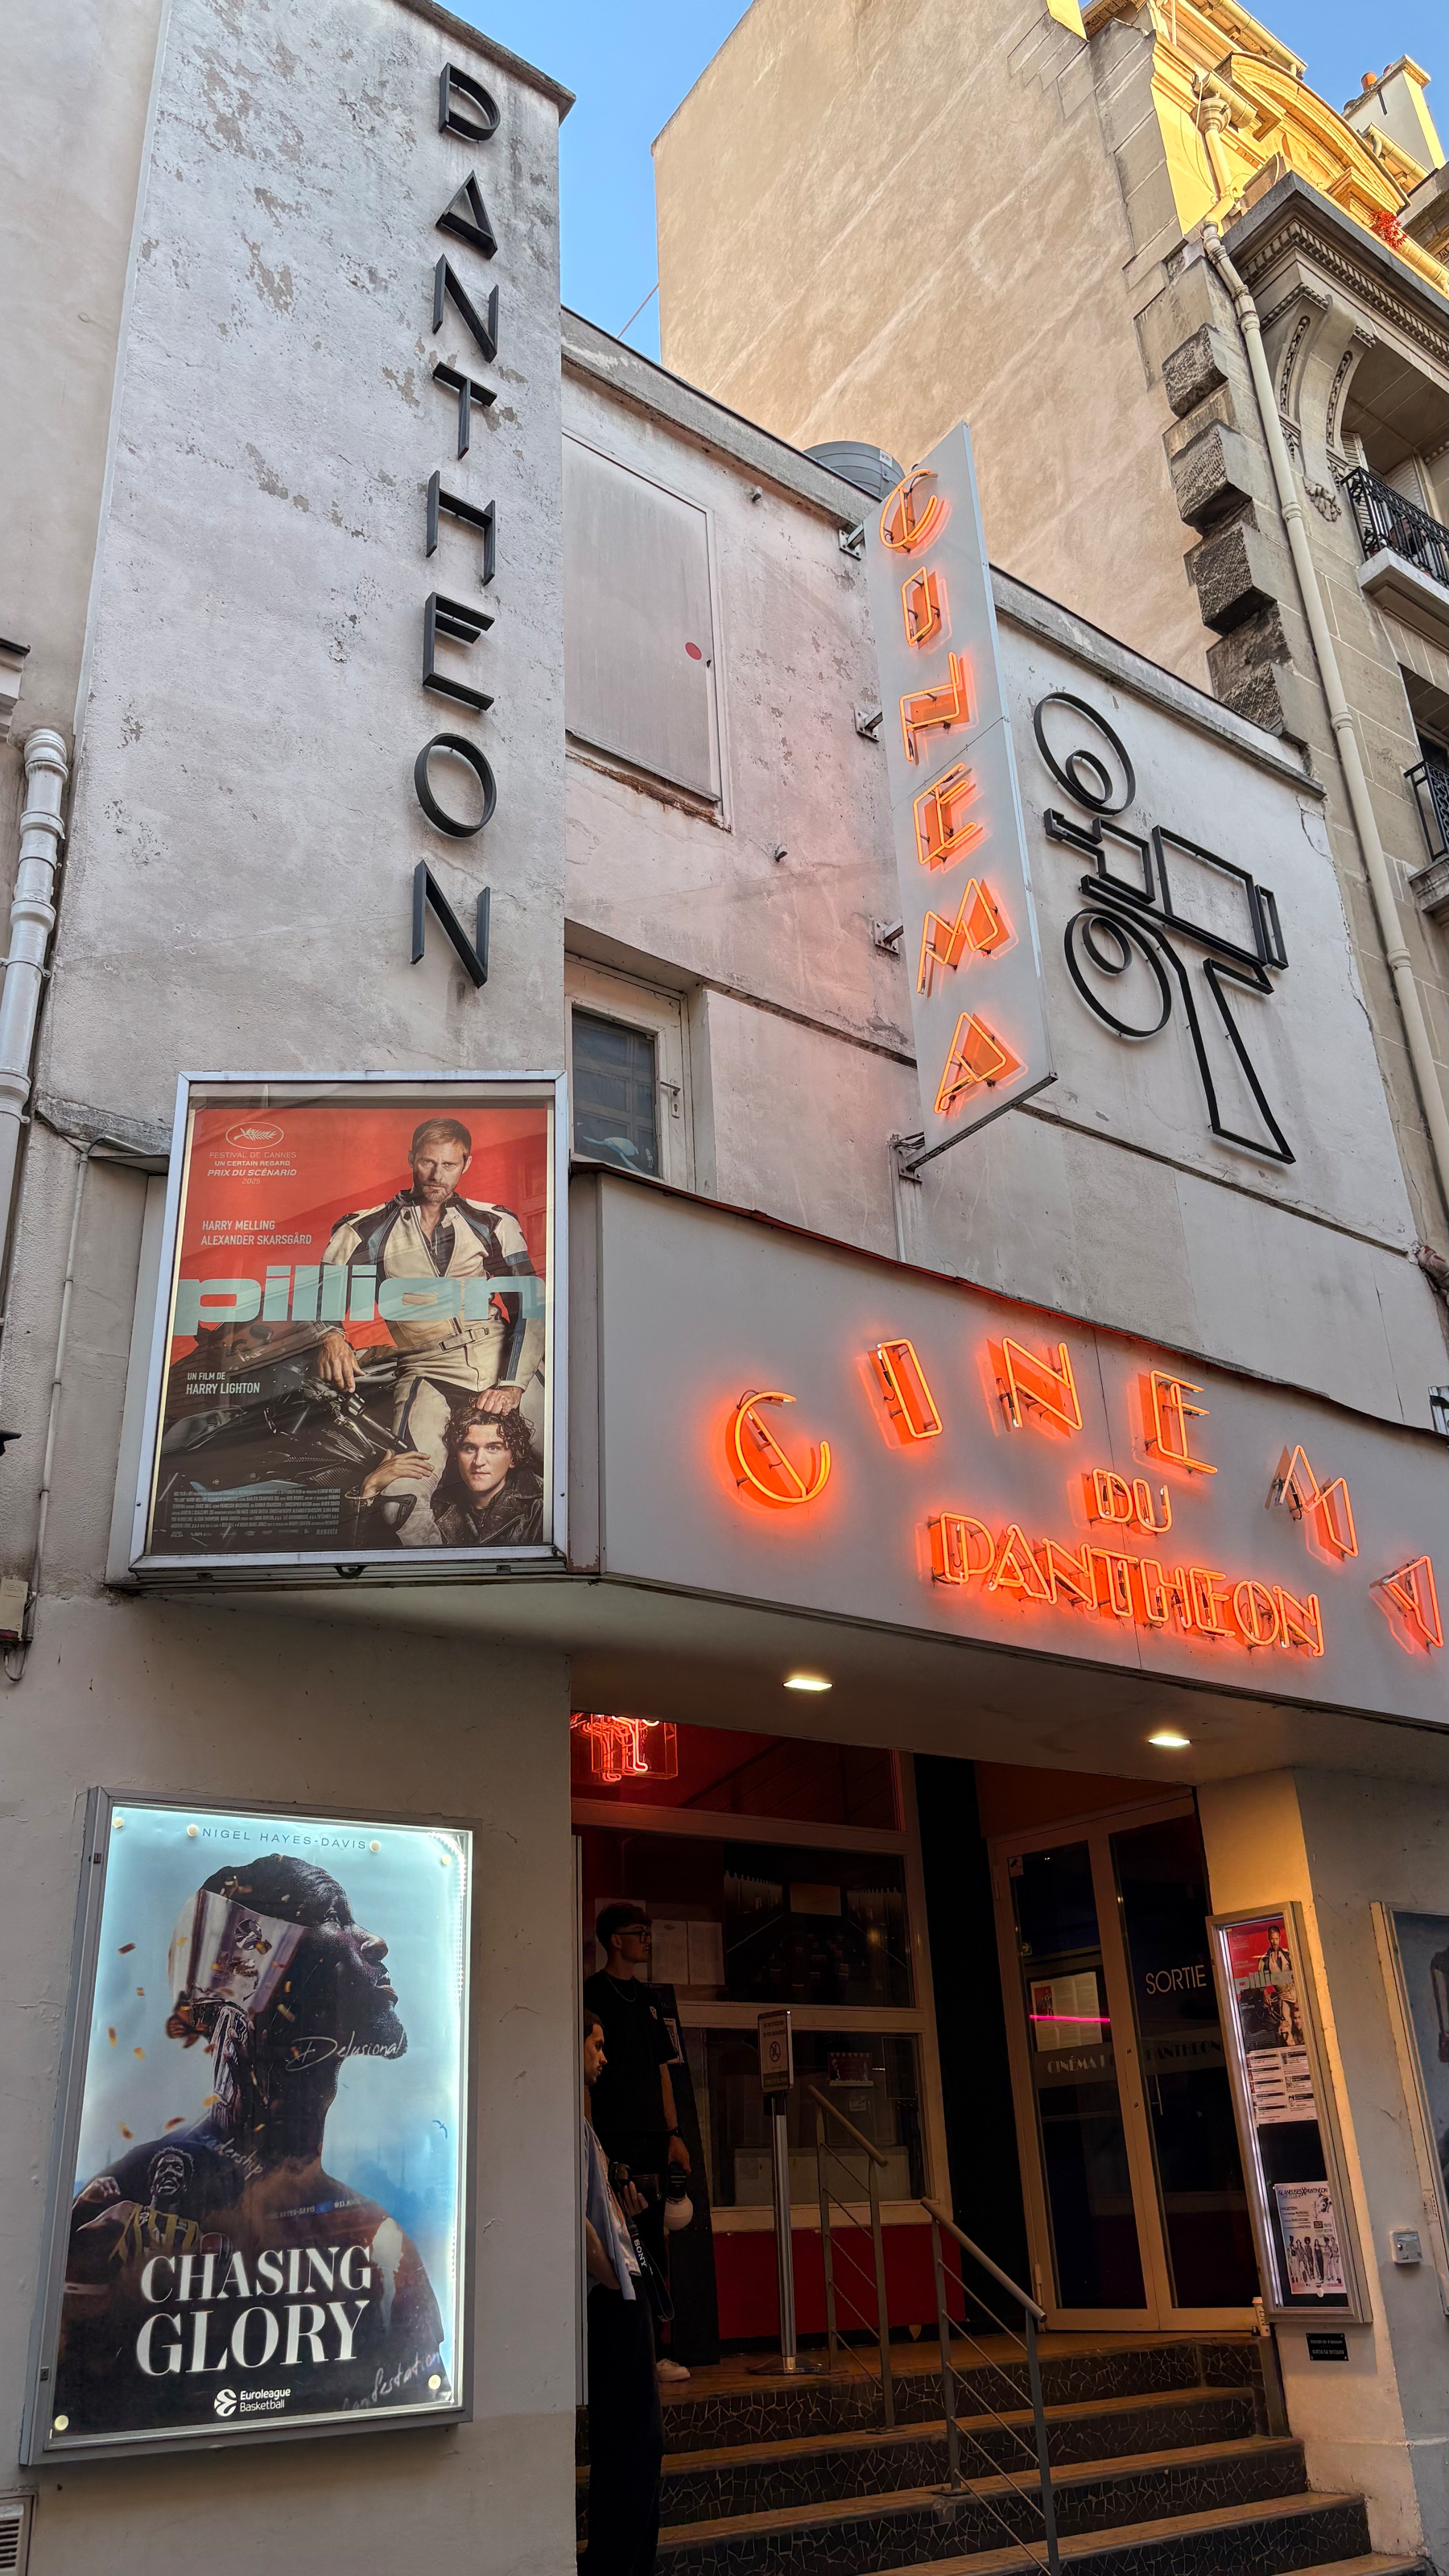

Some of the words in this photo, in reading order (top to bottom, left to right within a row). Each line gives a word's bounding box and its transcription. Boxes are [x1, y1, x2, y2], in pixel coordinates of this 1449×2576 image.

[410, 62, 501, 989] PANTHEON
[879, 469, 1006, 1114] CINEMA
[247, 1167, 297, 1176] SCÉNARIO
[200, 1235, 254, 1245] ALEXANDER
[257, 1232, 312, 1245] SKARSGÅRD
[202, 1220, 233, 1230] HARRY
[235, 1220, 275, 1230] MELLING
[172, 1265, 546, 1336] pillion
[186, 1383, 218, 1394] HARRY
[220, 1382, 260, 1394] LIGHTON
[187, 1372, 197, 1381] UN
[198, 1372, 215, 1381] FILM
[217, 1372, 225, 1380] DE
[733, 1336, 1444, 1648] CINEMA
[1091, 1468, 1170, 1533] DU
[936, 1511, 1324, 1657] PANTHEON
[202, 1828, 250, 1840] NIGEL
[260, 1832, 365, 1849] HAYES-DAVIS
[1145, 1964, 1207, 1995] SORTIE
[286, 2027, 405, 2071] Delusional
[1046, 2055, 1097, 2074] CINÉMA
[634, 2239, 647, 2268] SONY
[141, 2245, 371, 2303] CHASING
[136, 2300, 369, 2376] GLORY
[240, 2387, 291, 2401] Euroleague
[240, 2399, 285, 2412] Basketball
